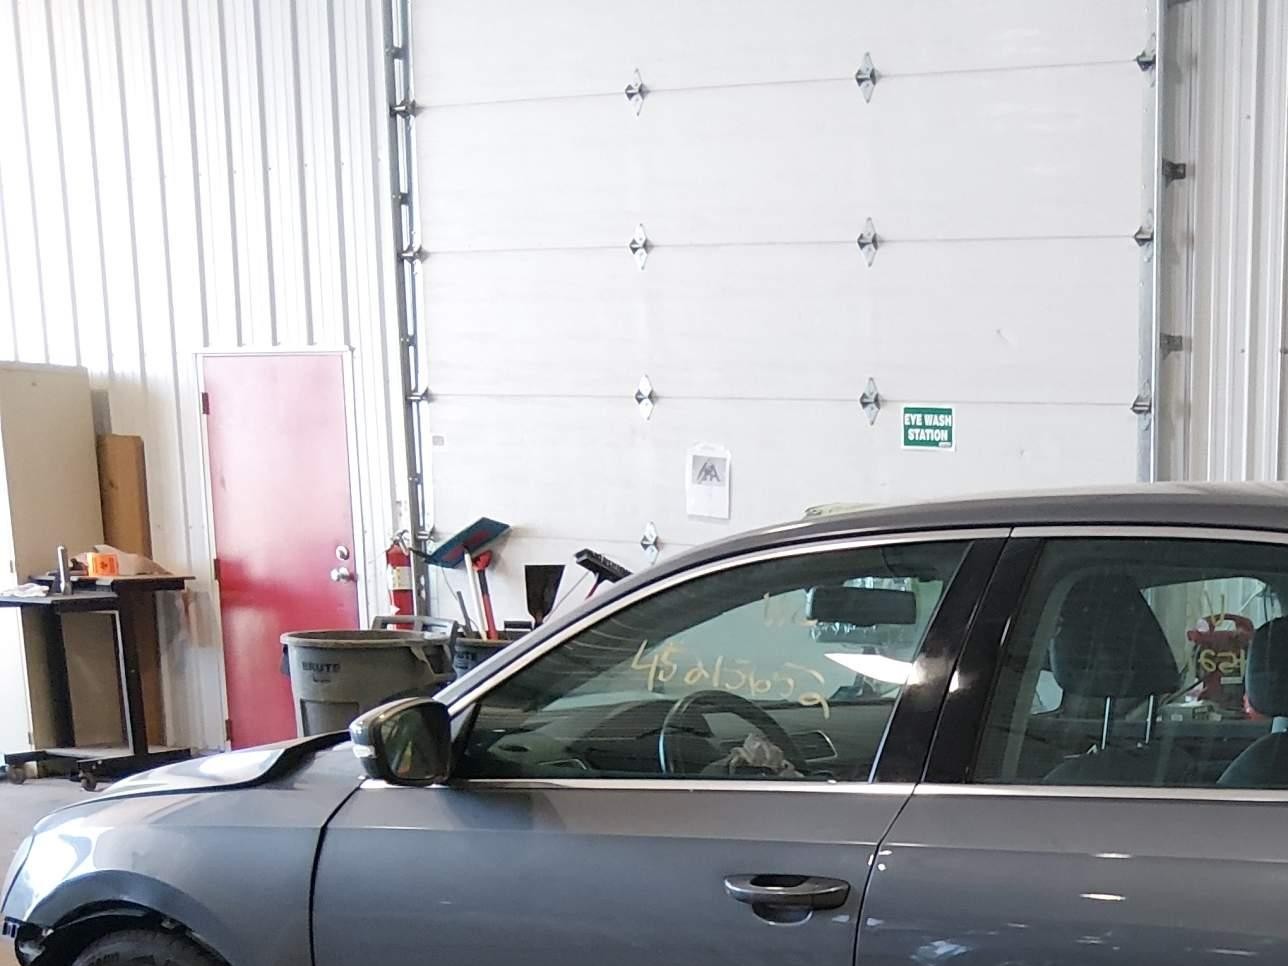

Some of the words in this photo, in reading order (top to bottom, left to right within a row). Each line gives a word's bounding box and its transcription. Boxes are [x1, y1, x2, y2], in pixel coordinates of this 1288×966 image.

[904, 413, 922, 426] EYE
[924, 413, 952, 427] WASH
[908, 428, 948, 442] STATION
